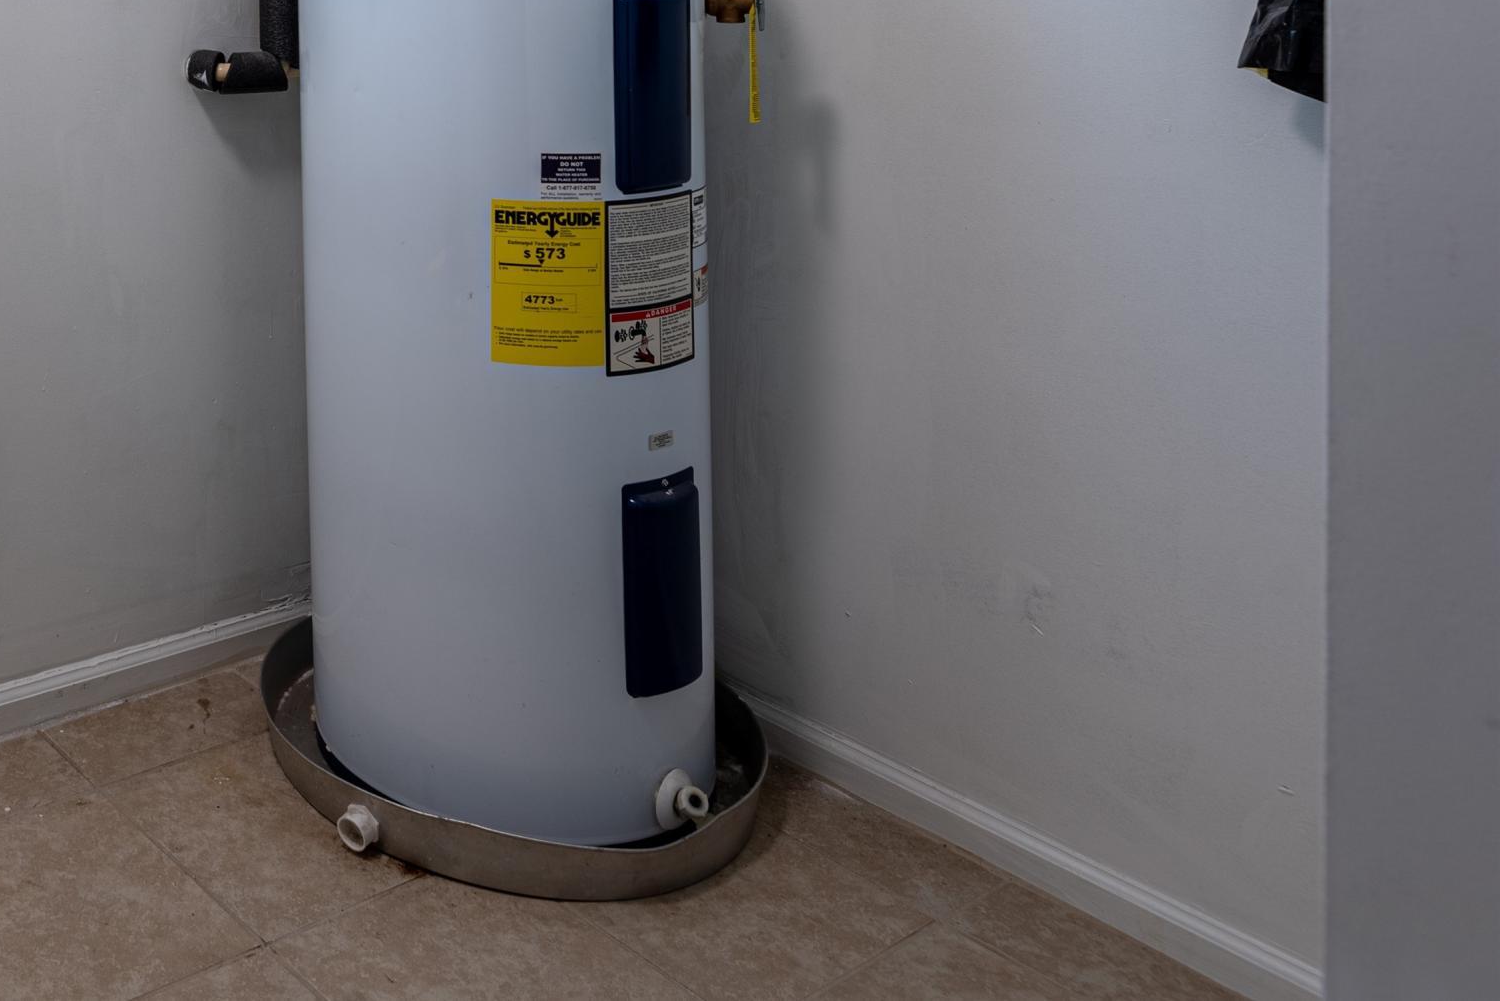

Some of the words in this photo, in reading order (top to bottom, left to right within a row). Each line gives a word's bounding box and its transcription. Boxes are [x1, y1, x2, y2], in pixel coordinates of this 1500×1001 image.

[495, 209, 601, 228] ENERGYGUIDE
[535, 247, 566, 260] 573
[524, 294, 556, 305] 4773
